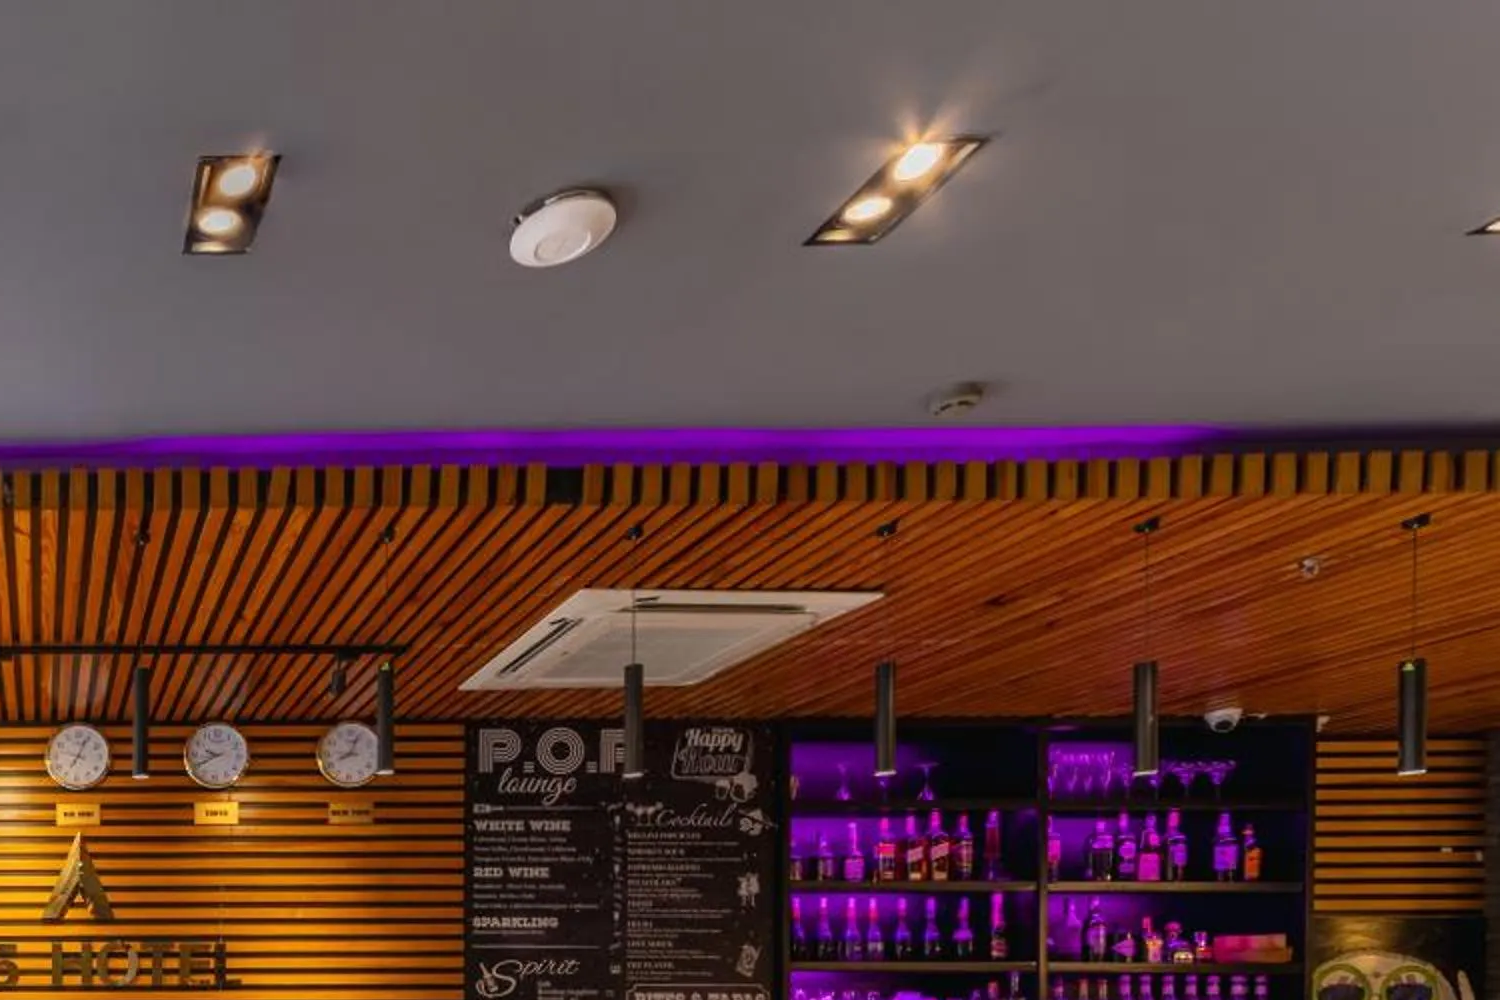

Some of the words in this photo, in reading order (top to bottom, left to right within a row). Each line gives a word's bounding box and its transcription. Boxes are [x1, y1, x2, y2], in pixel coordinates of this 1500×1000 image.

[684, 728, 745, 753] Happy
[498, 767, 578, 806] lounge
[473, 819, 525, 833] WHITE
[527, 819, 572, 833] WINE
[655, 803, 738, 828] Cocktail
[472, 866, 504, 879] RED
[507, 866, 550, 879] WINE
[472, 916, 560, 930] SPARKLING
[51, 937, 243, 991] HOTEL
[475, 958, 581, 999] Spirit
